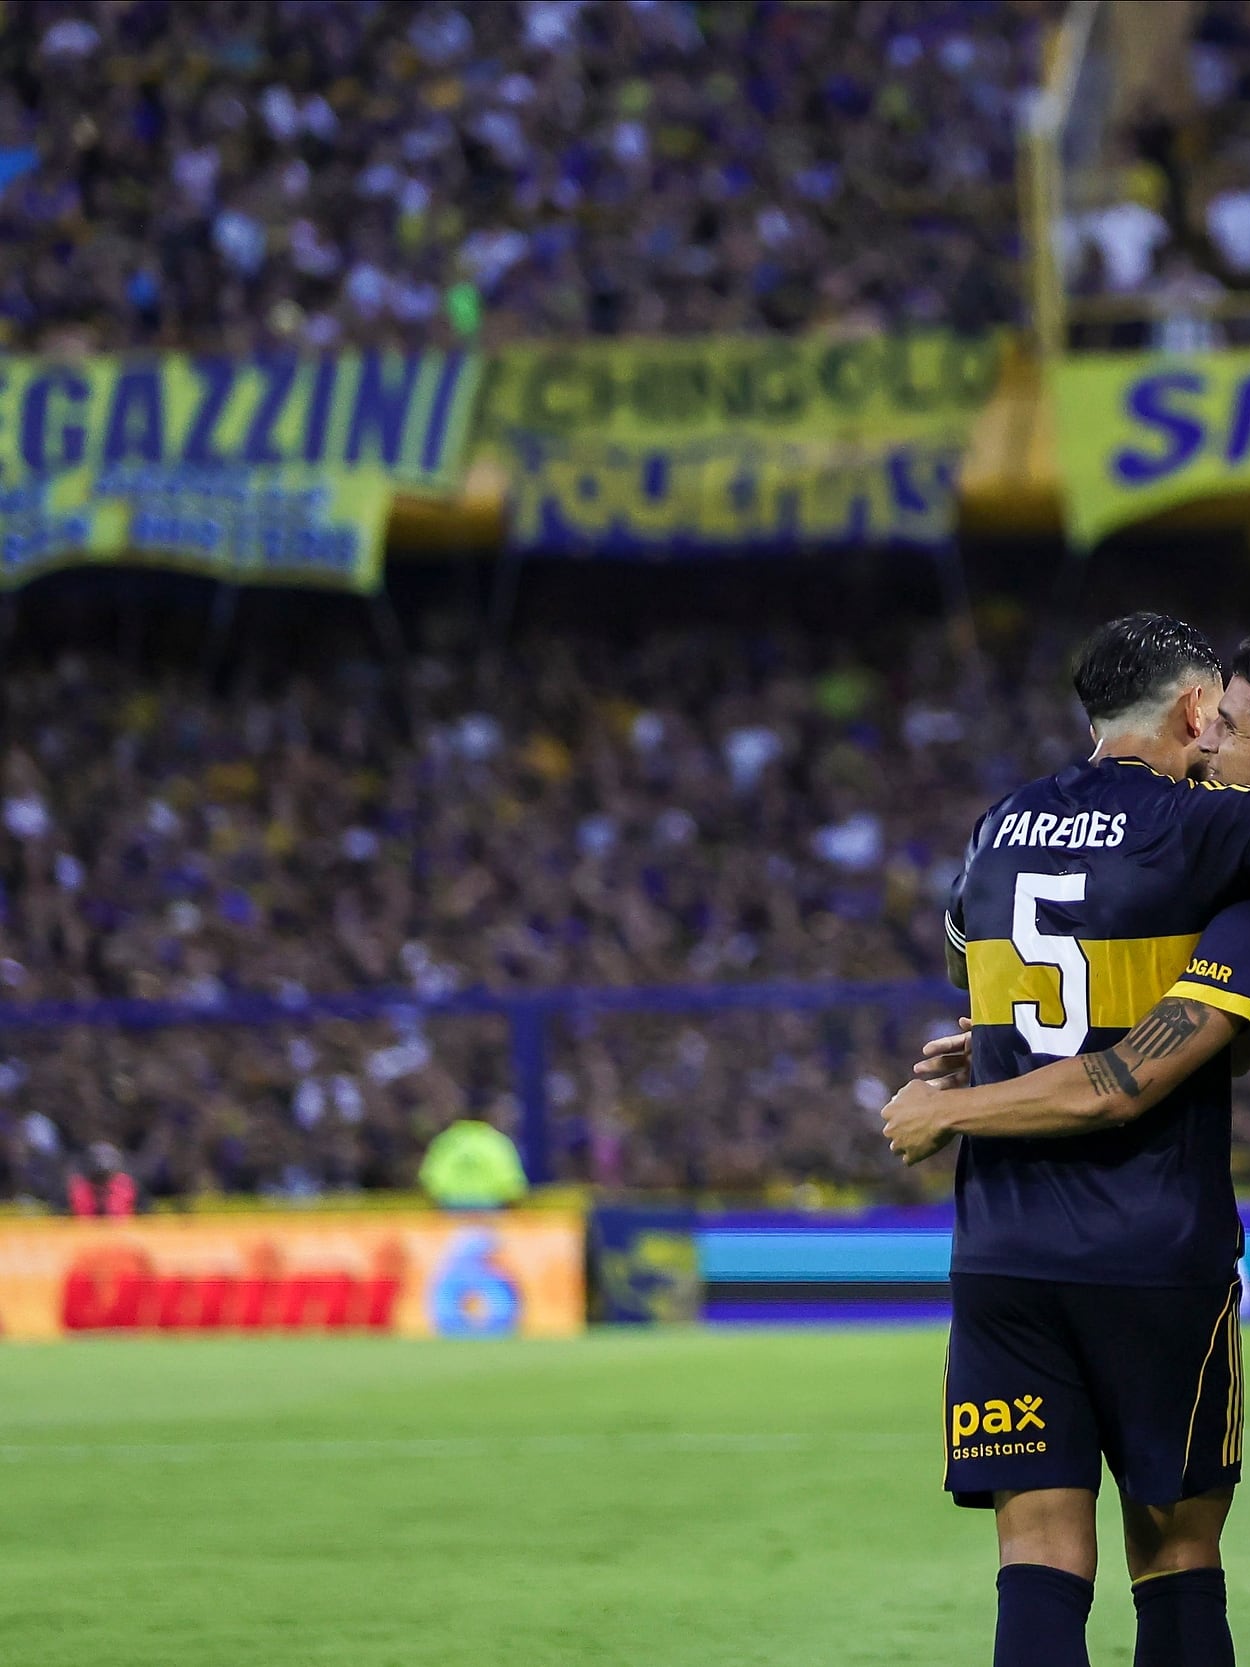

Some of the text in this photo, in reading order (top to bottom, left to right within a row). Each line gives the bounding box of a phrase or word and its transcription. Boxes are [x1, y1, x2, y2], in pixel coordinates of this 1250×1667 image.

[0, 350, 465, 473] GAZZINI
[994, 811, 1126, 848] PAREDES
[1012, 872, 1089, 1057] 5
[428, 1226, 523, 1340] 6
[952, 1394, 1046, 1447] pax
[952, 1441, 1047, 1460] assistance
